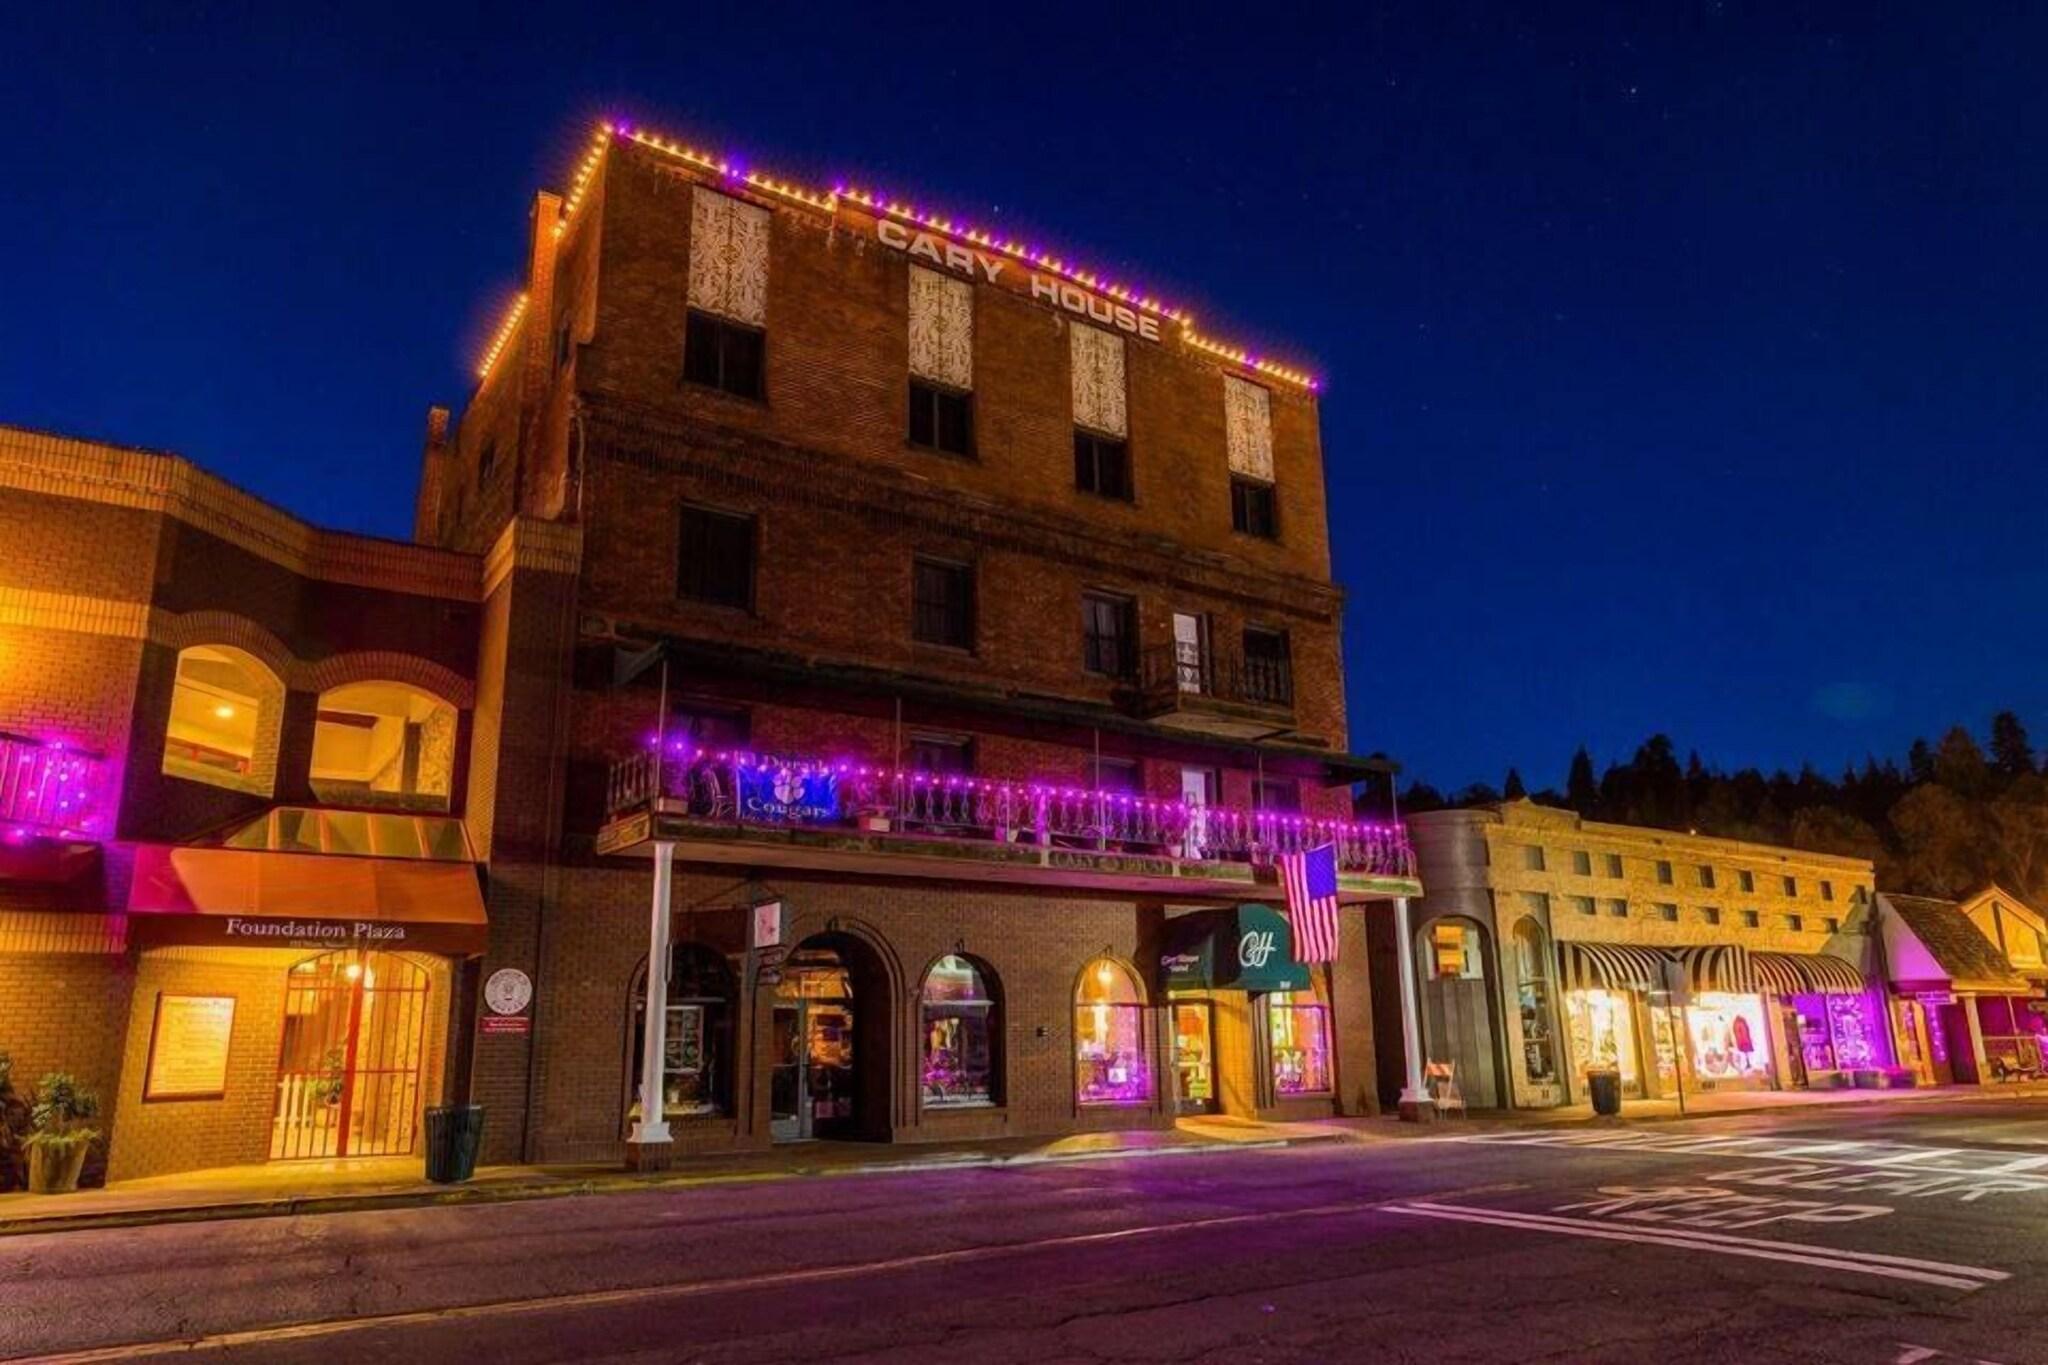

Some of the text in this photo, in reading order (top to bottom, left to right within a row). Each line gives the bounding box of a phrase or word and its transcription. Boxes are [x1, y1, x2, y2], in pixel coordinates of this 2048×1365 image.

[878, 218, 1160, 342] CARY HOUSE
[747, 797, 833, 820] Cougars
[226, 918, 406, 940] Foundation Plaza
[1551, 1191, 1896, 1230] KEEP
